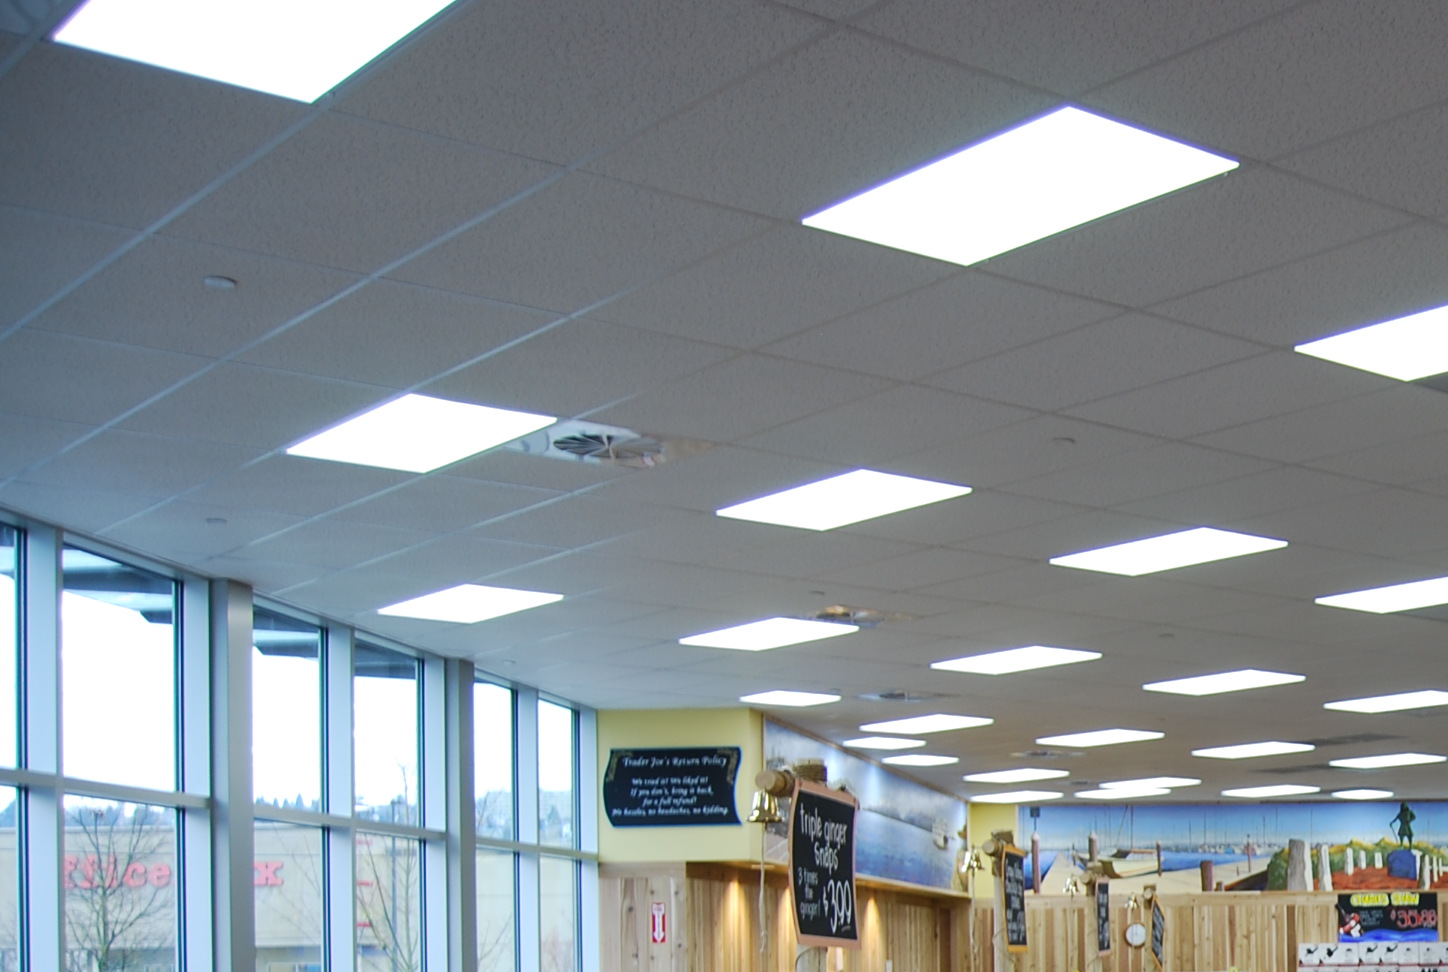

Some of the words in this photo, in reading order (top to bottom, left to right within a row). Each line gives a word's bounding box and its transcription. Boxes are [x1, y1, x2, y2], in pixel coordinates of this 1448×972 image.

[623, 757, 649, 766] Trader
[650, 756, 670, 768] Joe's
[672, 756, 700, 766] Return
[701, 754, 727, 767] Policy
[800, 802, 822, 842] triple
[824, 820, 848, 850] ginger
